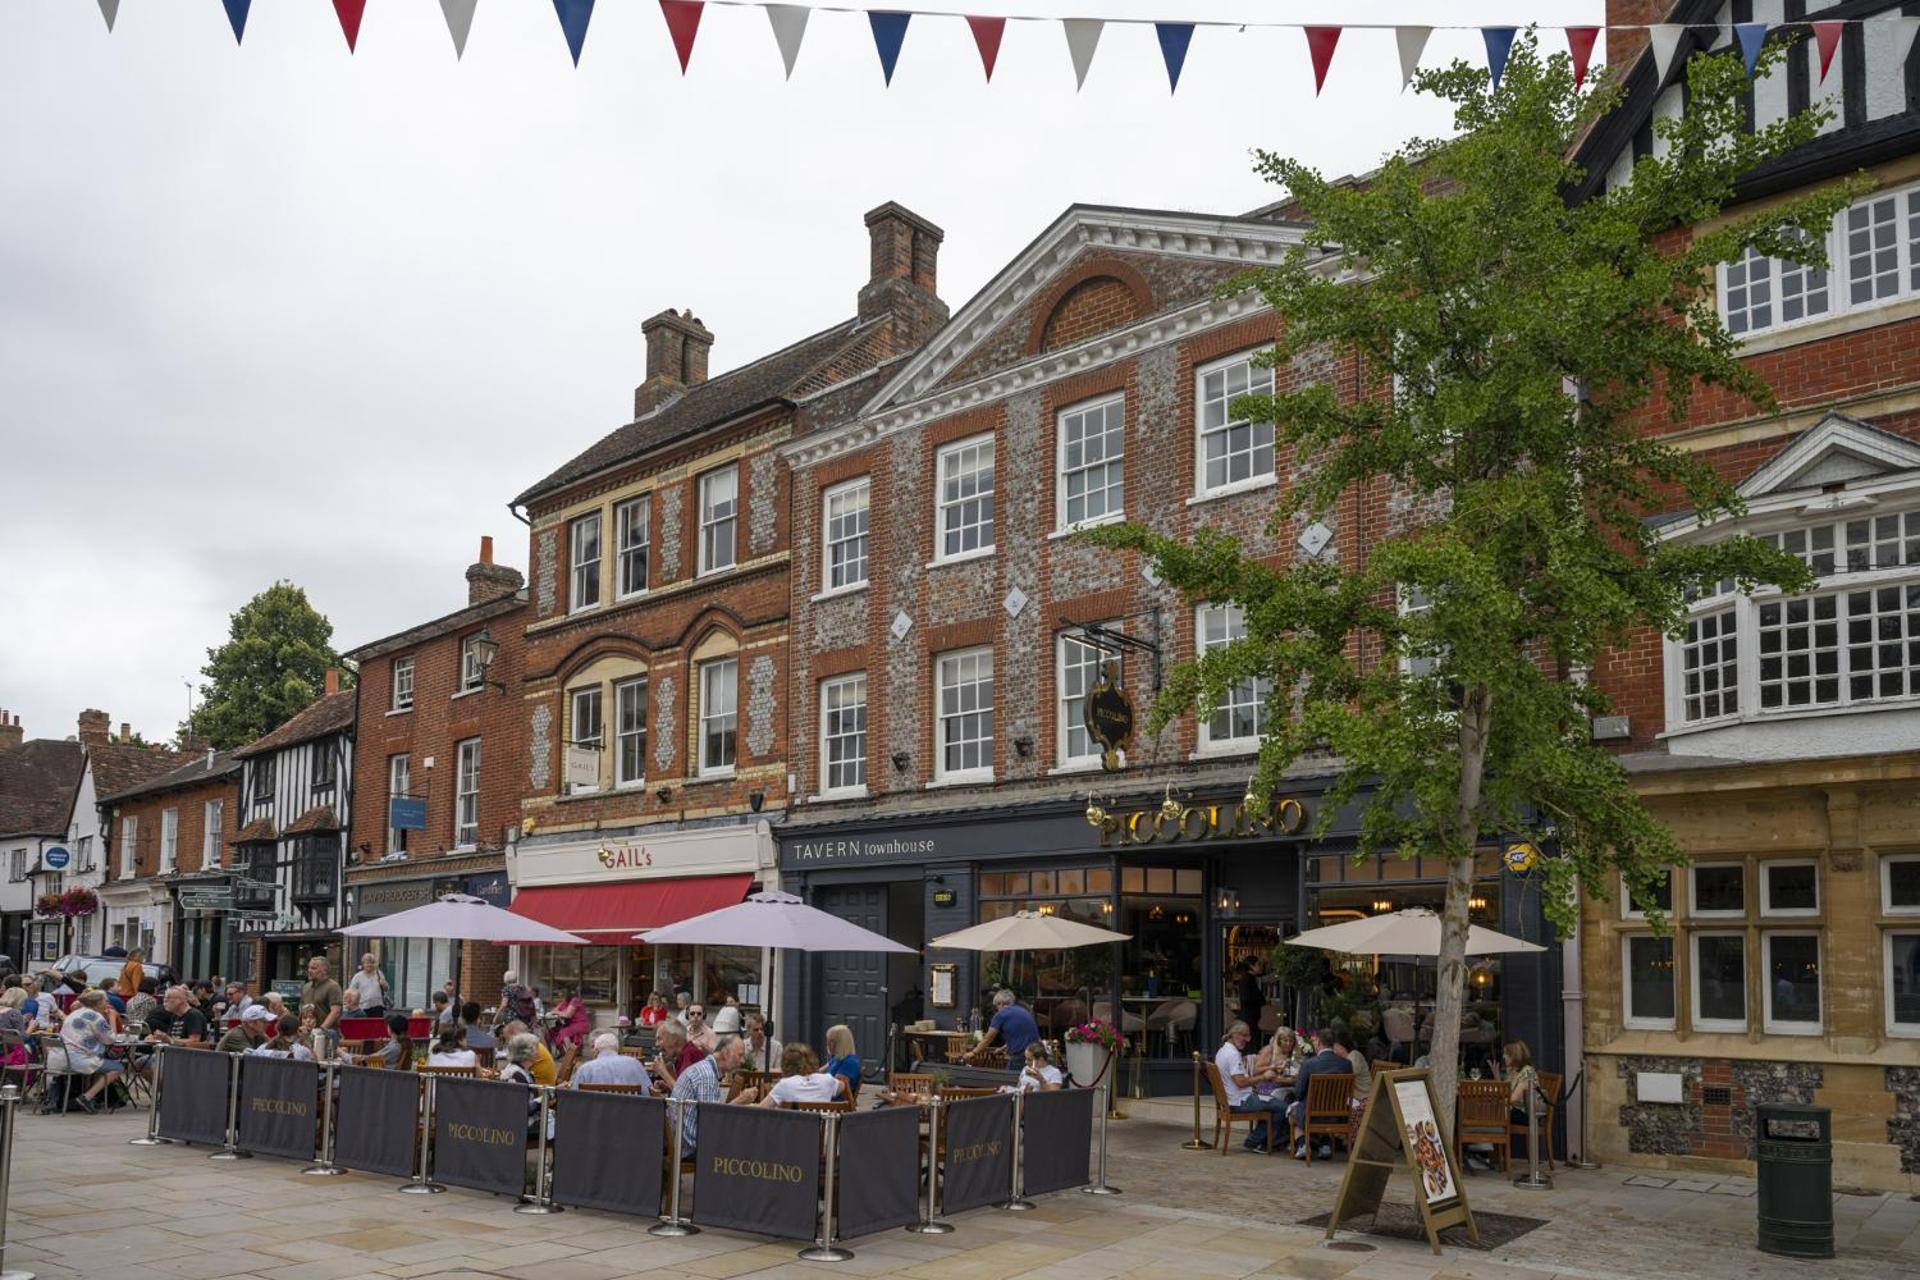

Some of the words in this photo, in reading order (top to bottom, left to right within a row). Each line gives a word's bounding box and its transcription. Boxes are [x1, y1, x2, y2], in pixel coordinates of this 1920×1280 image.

[604, 847, 653, 869] GAIL's
[793, 840, 860, 861] TAVERN
[864, 838, 935, 857] townhouse
[448, 1122, 515, 1145] PICCOLINO
[712, 1156, 803, 1183] PICCOLINO
